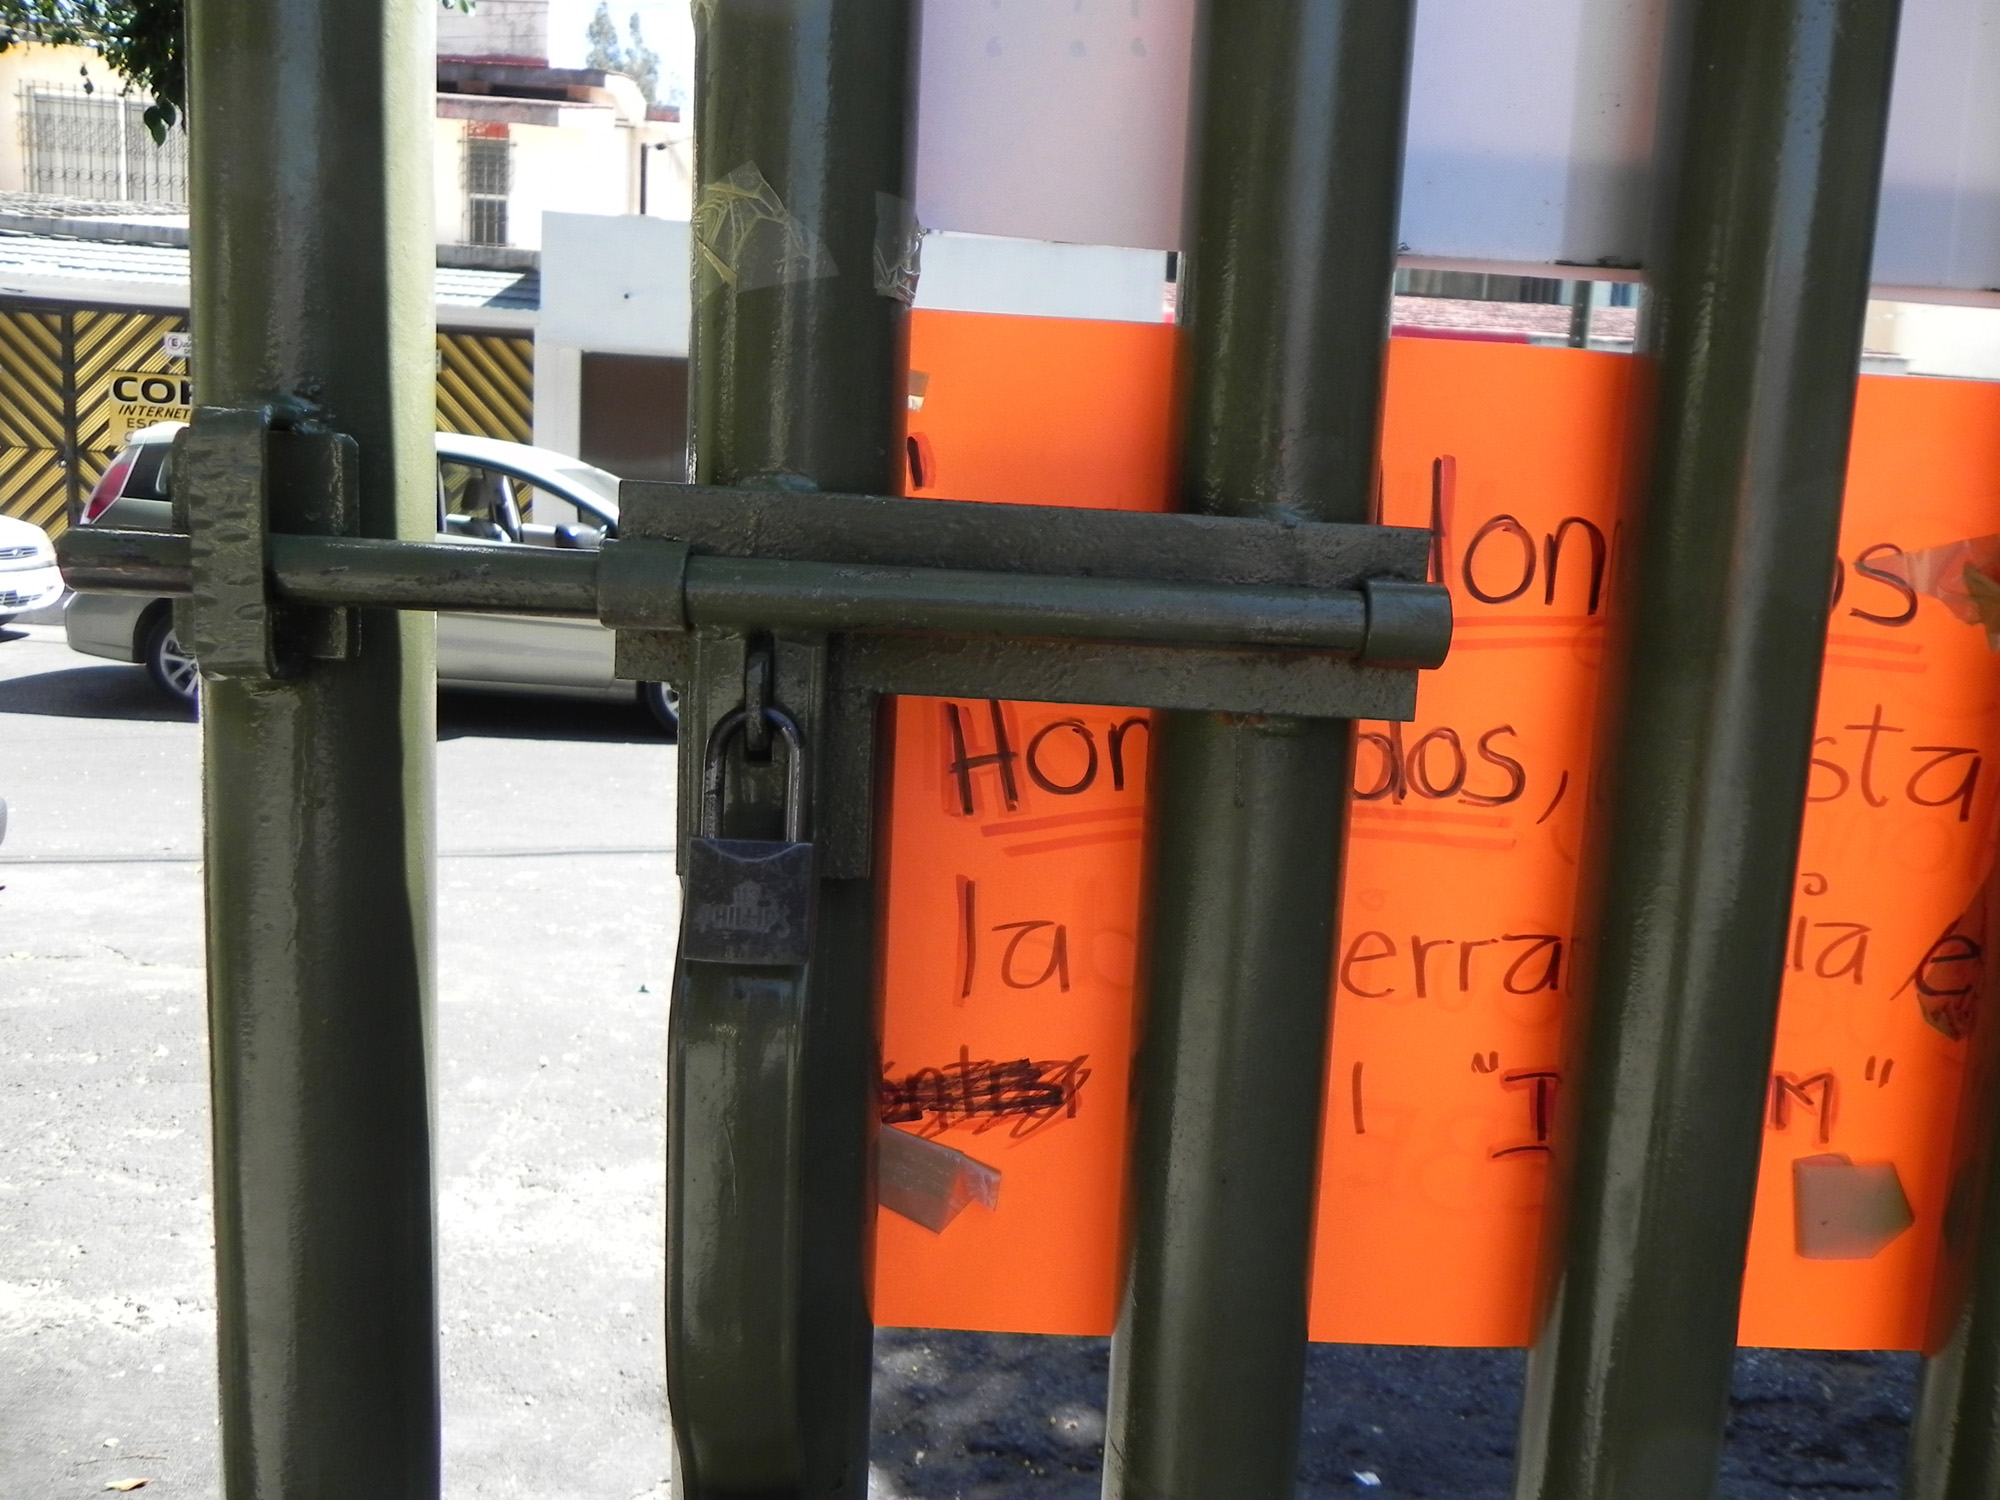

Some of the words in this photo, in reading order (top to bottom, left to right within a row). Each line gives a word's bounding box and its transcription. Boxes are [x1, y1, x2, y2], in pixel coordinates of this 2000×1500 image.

[119, 405, 191, 419] INTERNET
[1808, 703, 1982, 822] sta
[958, 879, 1069, 999] la
[1340, 930, 1563, 998] erra
